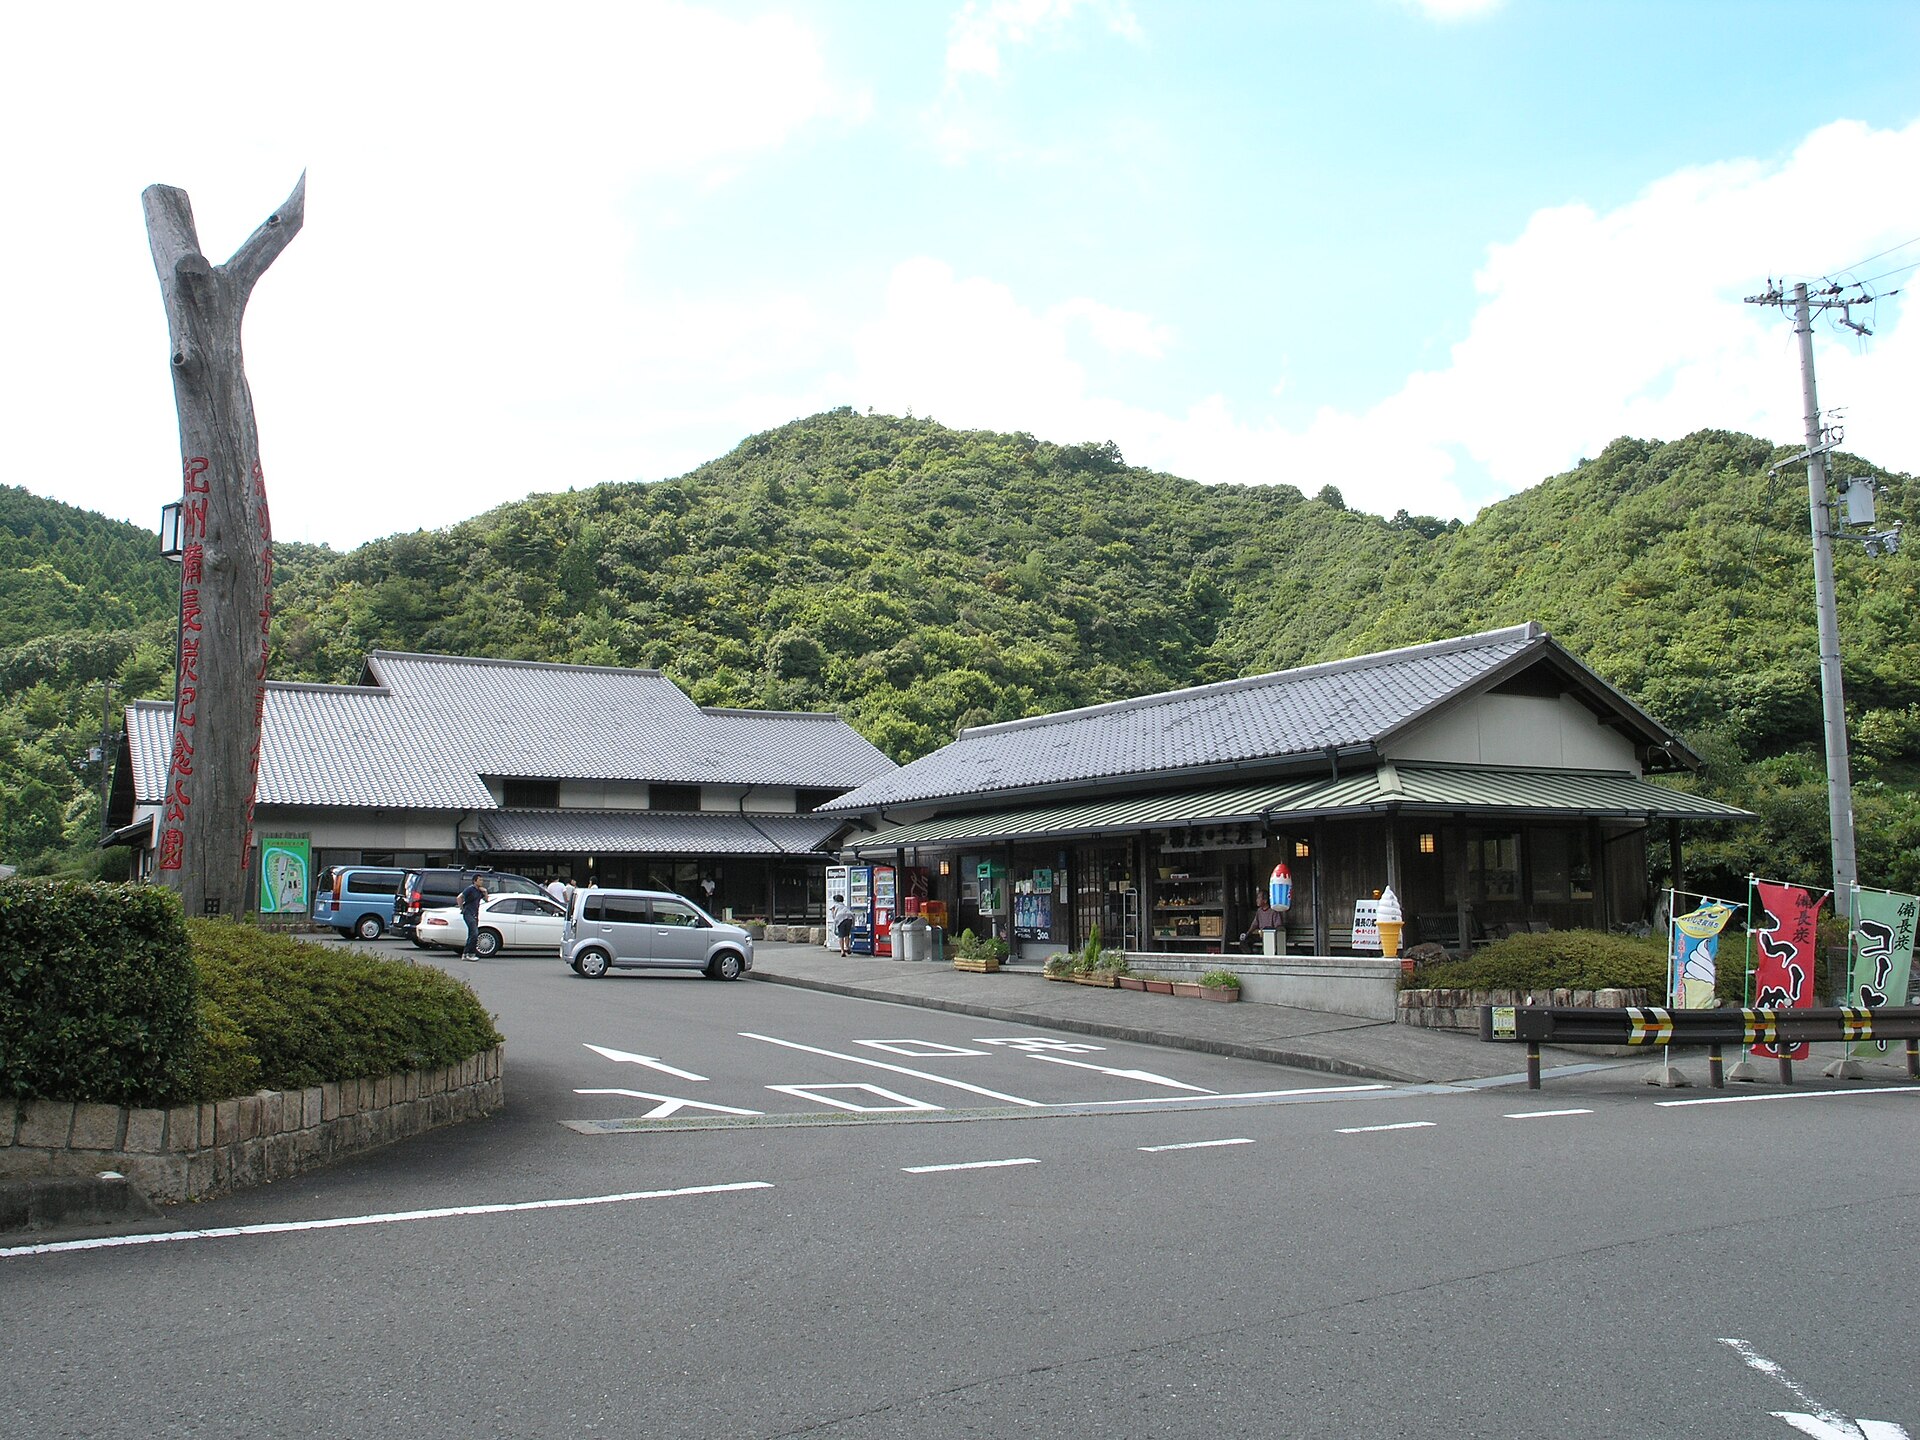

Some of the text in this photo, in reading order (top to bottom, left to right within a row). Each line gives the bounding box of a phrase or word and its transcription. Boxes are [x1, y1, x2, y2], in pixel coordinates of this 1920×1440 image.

[1792, 893, 1814, 944] 備長炭
[1893, 901, 1917, 951] 備長炭
